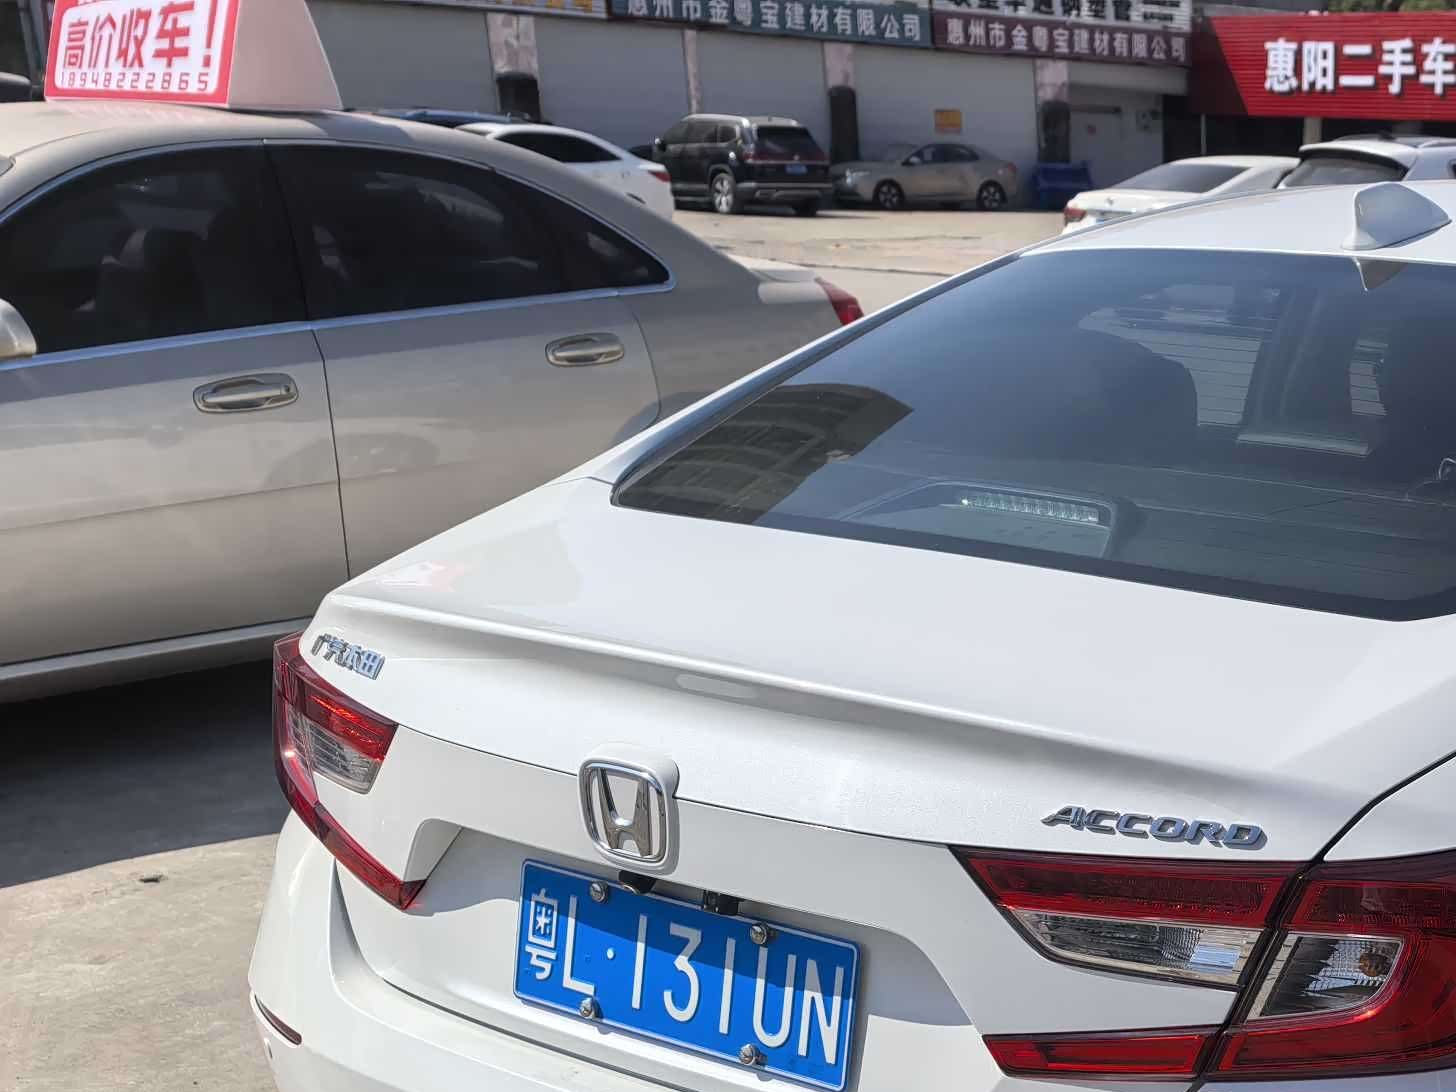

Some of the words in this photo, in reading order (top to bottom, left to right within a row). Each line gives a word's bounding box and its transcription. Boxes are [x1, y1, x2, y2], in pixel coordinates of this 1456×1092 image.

[946, 18, 1187, 62] 惠州市金粤宝建材有限公司
[61, 71, 210, 92] 18948222865
[311, 633, 386, 681] 广汽本田
[1040, 804, 1268, 851] ACCORD
